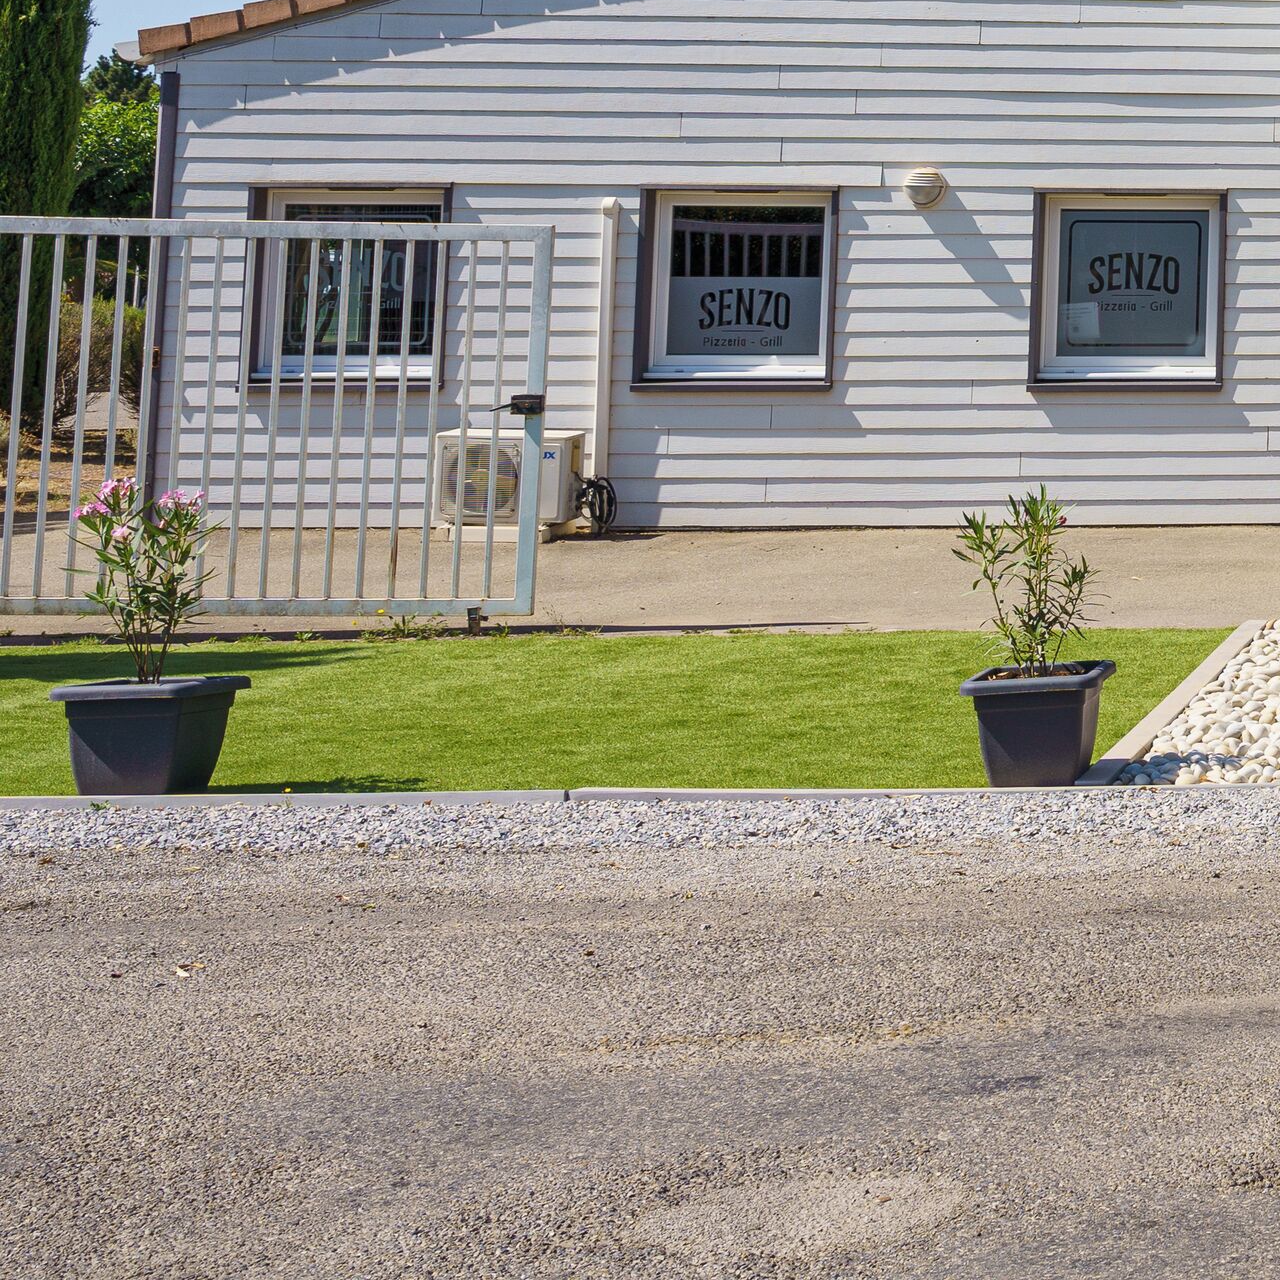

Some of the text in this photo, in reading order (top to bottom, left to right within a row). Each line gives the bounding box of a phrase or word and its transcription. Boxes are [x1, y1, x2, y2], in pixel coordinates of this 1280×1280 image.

[1088, 252, 1180, 295] SENZO
[698, 288, 791, 330] SENZO
[1150, 301, 1173, 311] Grill
[703, 336, 746, 347] Pizzeria
[760, 336, 783, 347] Grill
